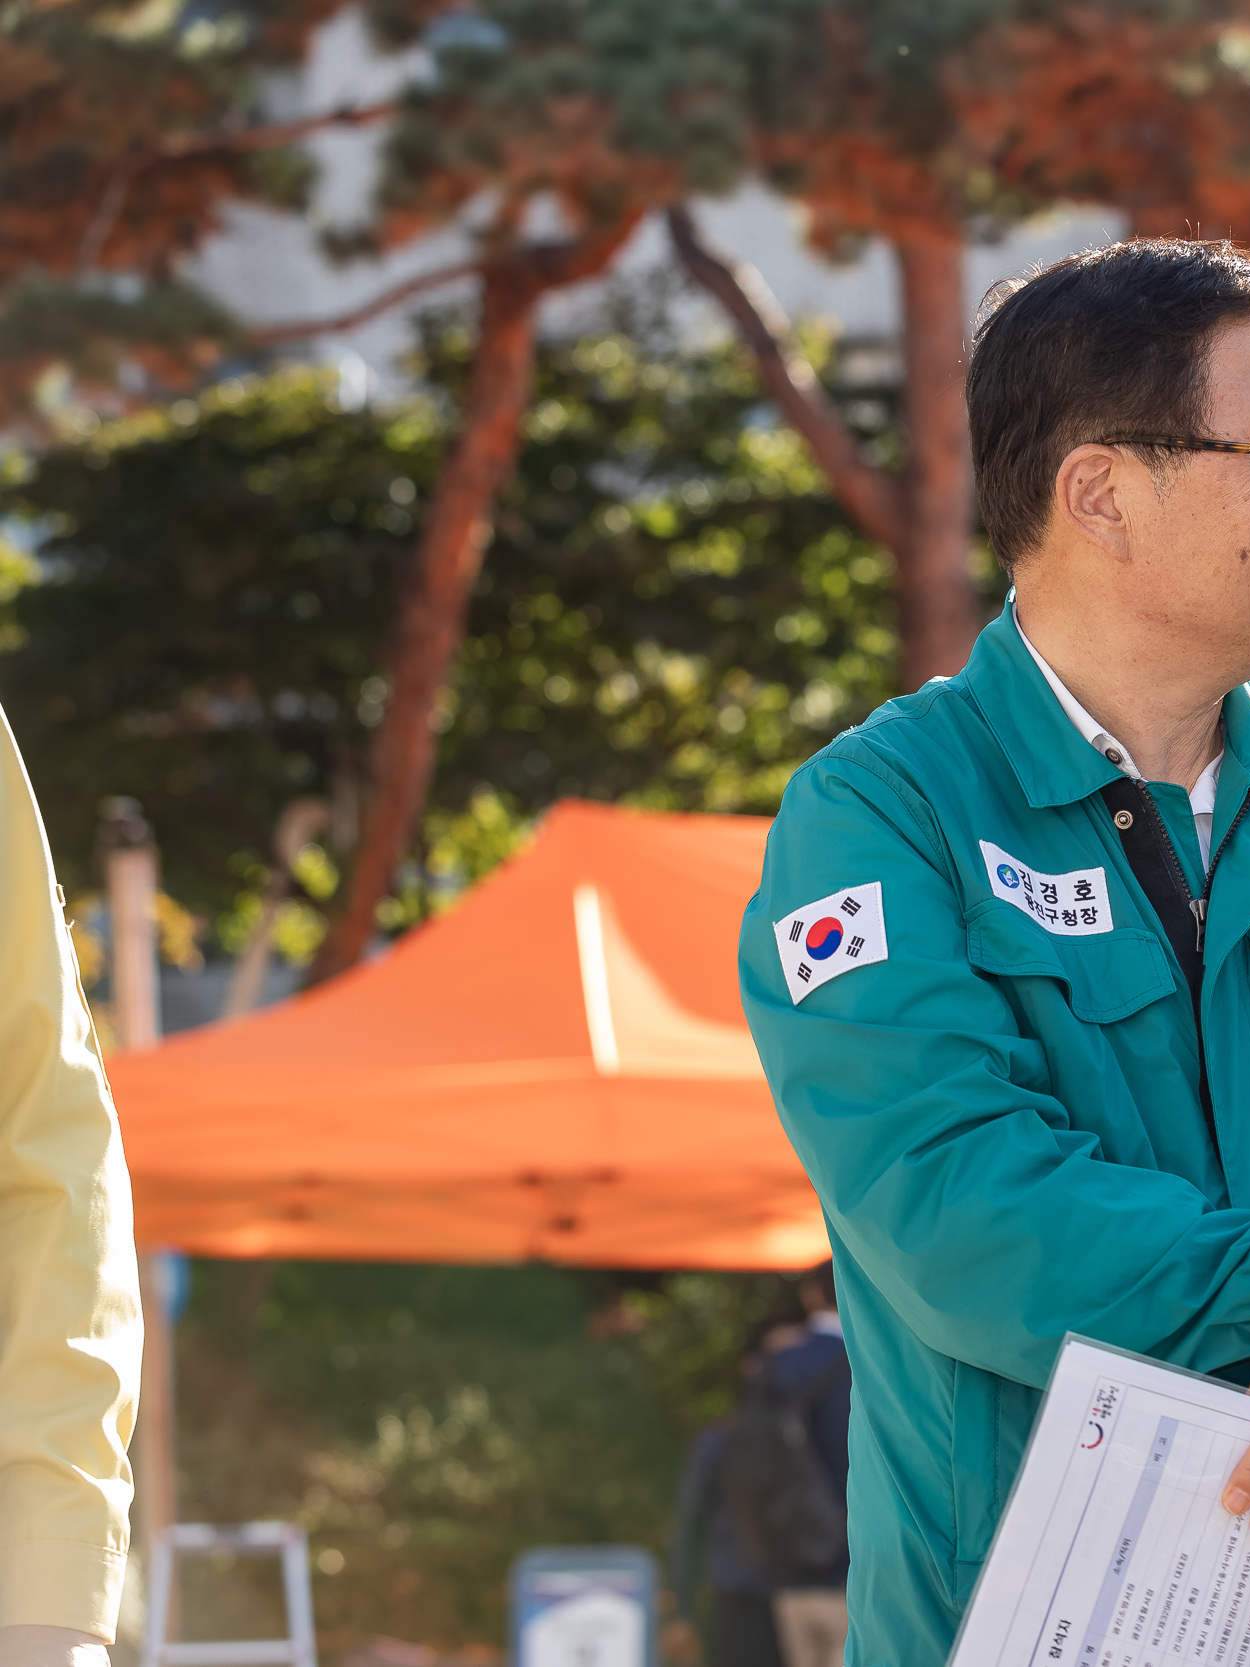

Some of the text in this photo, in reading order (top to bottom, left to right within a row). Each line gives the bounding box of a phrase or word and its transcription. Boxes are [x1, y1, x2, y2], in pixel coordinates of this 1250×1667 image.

[1024, 891, 1098, 927] 광진구청장
[1113, 1583, 1135, 1634] 광진소방서장
[1132, 1588, 1154, 1640] 광진경찰서장
[1173, 1608, 1191, 1652] 건국대학교
[1048, 1619, 1071, 1658] 참석자
